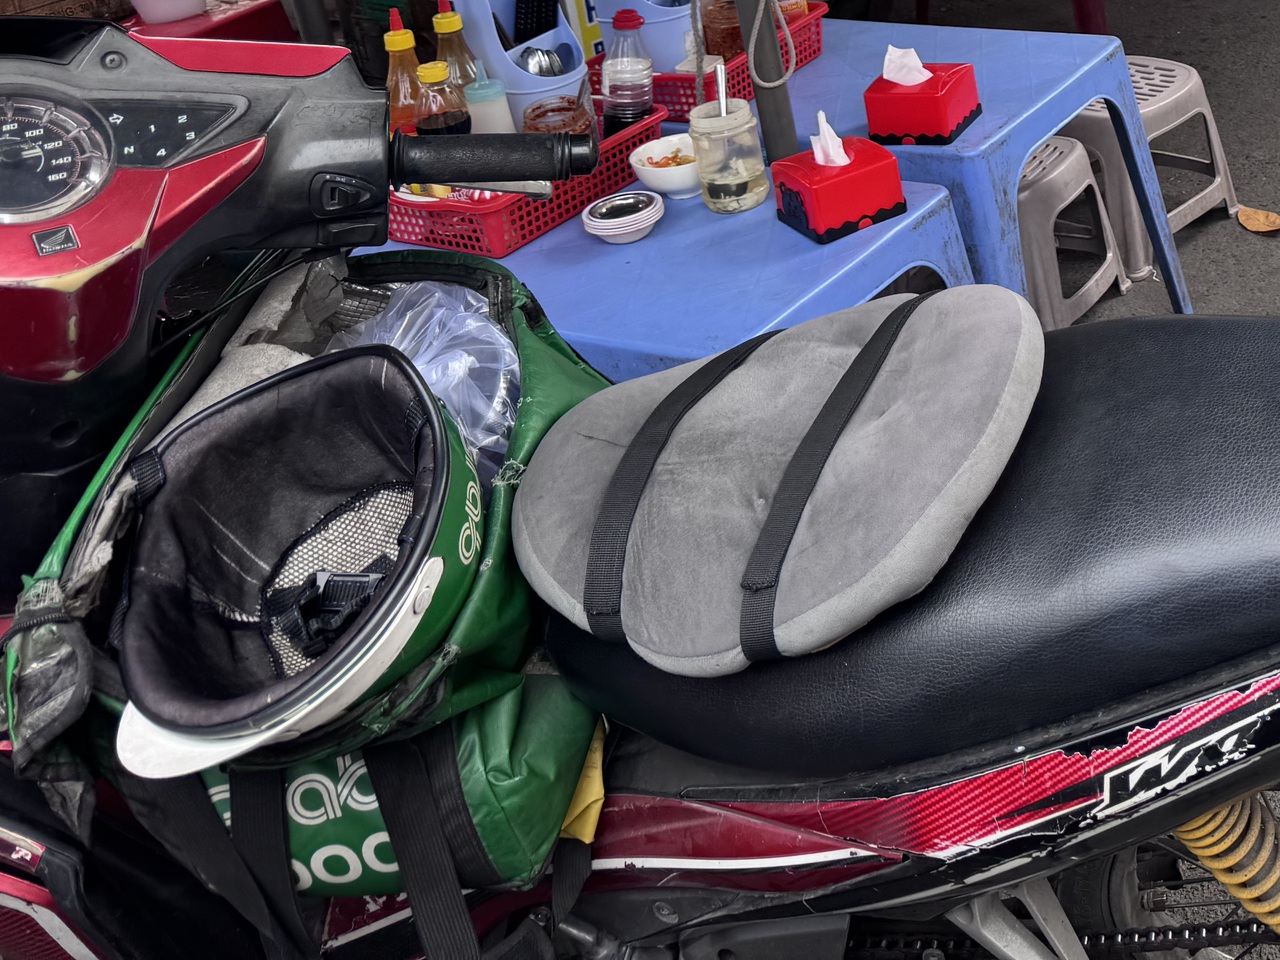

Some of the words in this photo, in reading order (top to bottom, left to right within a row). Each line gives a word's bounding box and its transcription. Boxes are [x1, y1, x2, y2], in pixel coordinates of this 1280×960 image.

[177, 114, 188, 124] 2
[24, 128, 44, 138] 100
[149, 124, 156, 133] 1
[185, 131, 196, 141] 3
[43, 140, 63, 150] 120
[123, 145, 135, 155] N
[156, 148, 167, 157] 4
[51, 155, 72, 166] 140
[47, 171, 67, 182] 160
